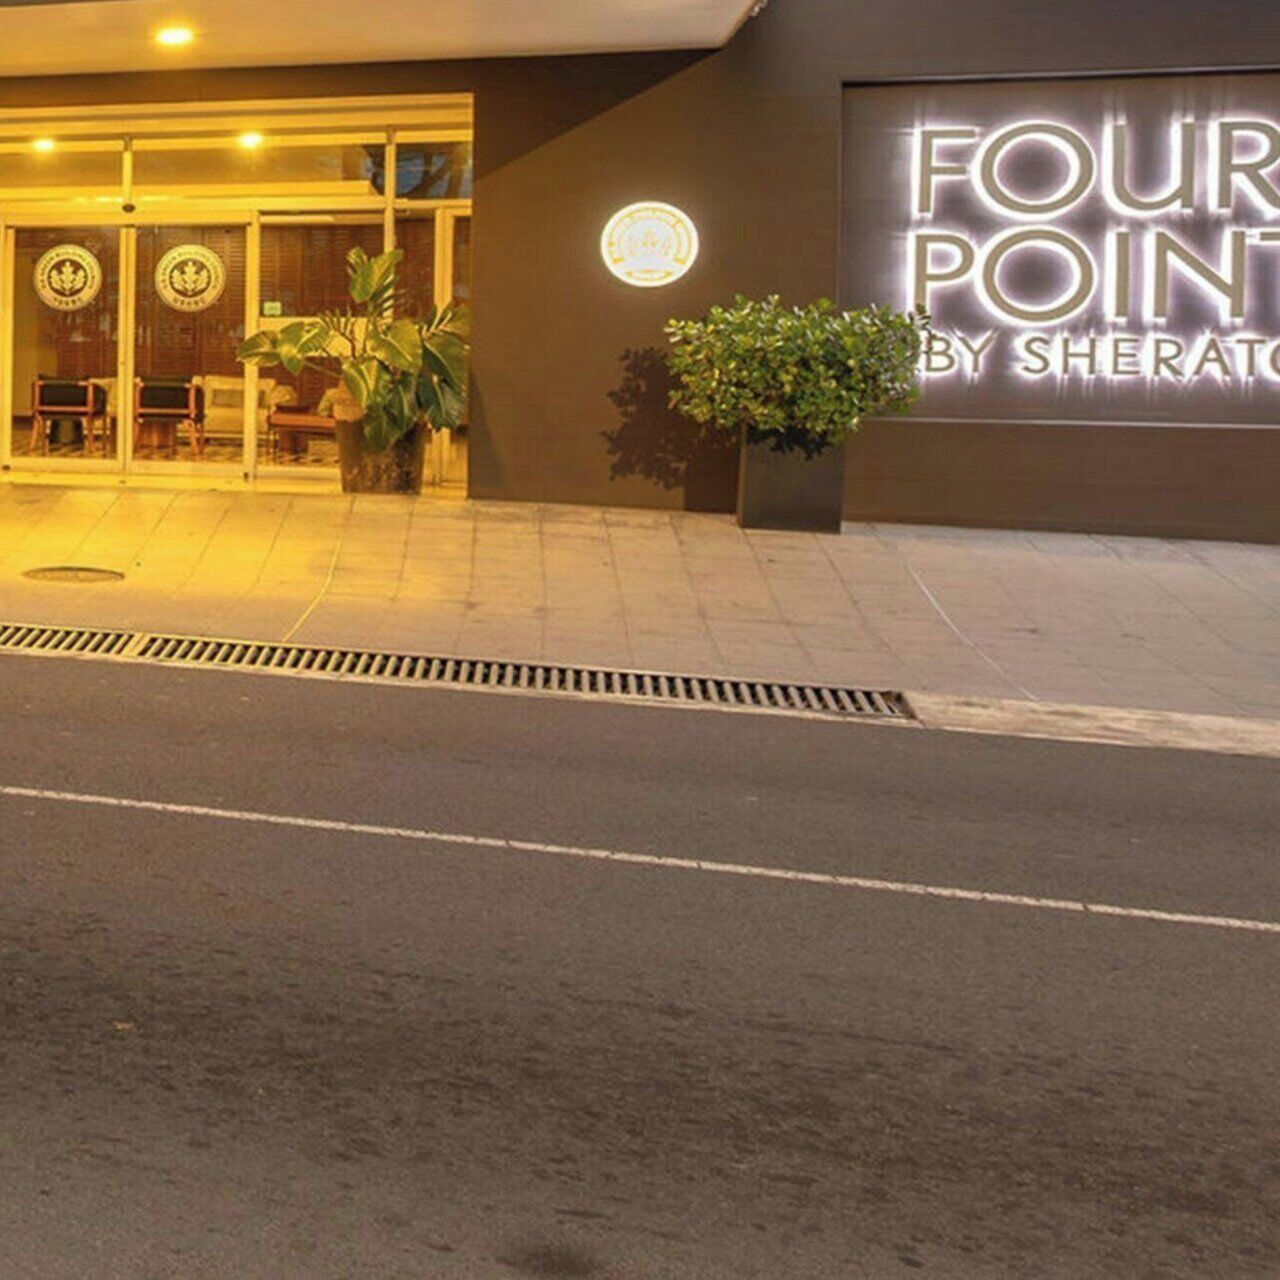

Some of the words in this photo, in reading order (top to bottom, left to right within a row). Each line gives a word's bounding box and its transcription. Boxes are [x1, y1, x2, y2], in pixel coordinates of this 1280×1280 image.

[917, 120, 1280, 214] FOUR
[914, 228, 1280, 322] POIN
[924, 334, 996, 374] BY
[1021, 335, 1280, 377] SHERAT
